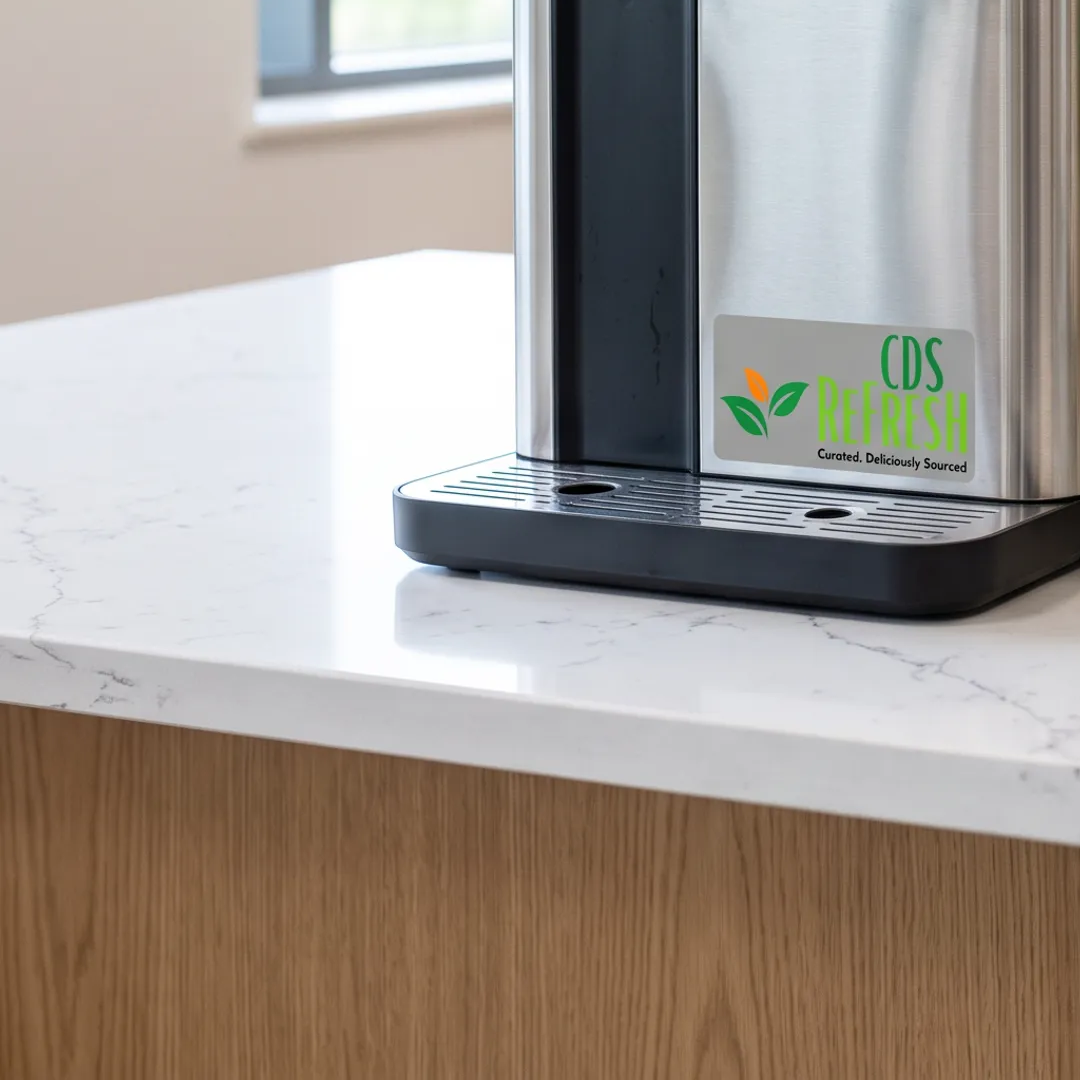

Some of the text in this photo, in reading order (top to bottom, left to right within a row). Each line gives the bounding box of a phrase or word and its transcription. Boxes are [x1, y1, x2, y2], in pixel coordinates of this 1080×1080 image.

[880, 334, 944, 392] CDS
[817, 448, 967, 473] Curated. Deliciously Sourced
